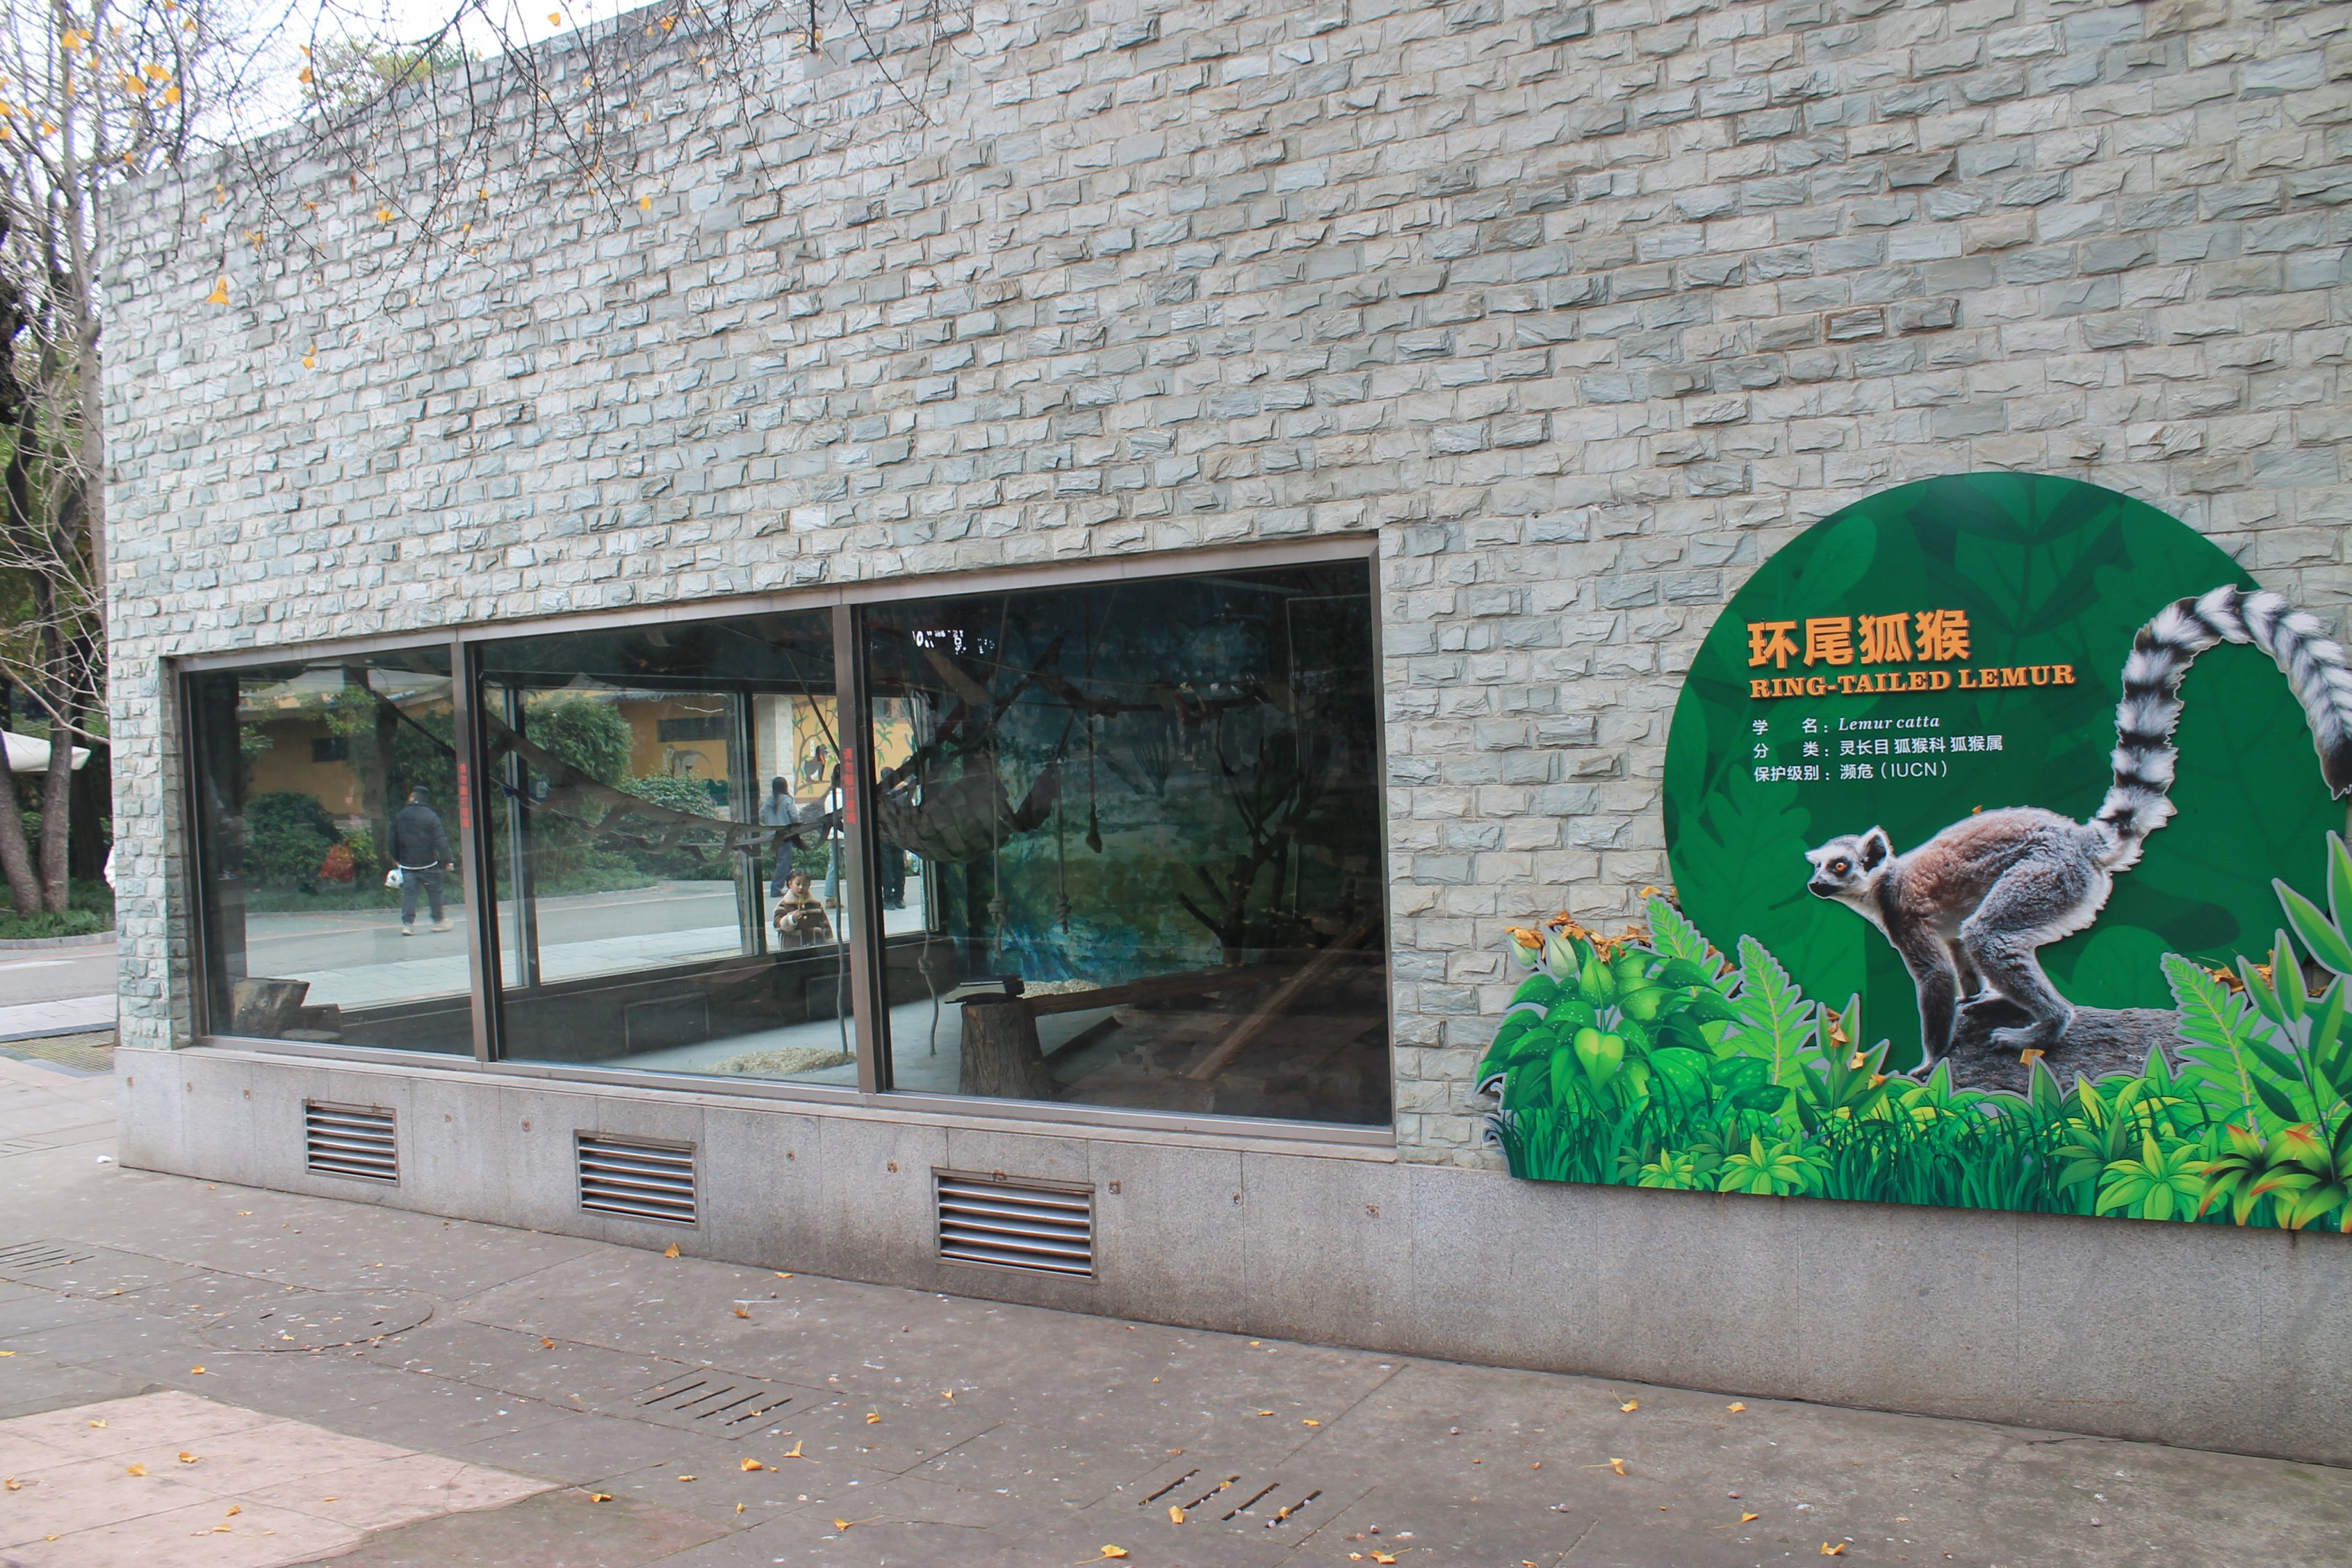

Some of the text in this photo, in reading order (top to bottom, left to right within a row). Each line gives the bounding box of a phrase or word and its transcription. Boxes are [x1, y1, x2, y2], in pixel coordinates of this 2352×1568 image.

[1747, 609, 1970, 669] 环尾狐猴
[1749, 664, 2075, 698] RING-TAILED LEMUR
[1839, 717, 1893, 731] Lemur
[1896, 716, 1940, 729] catta
